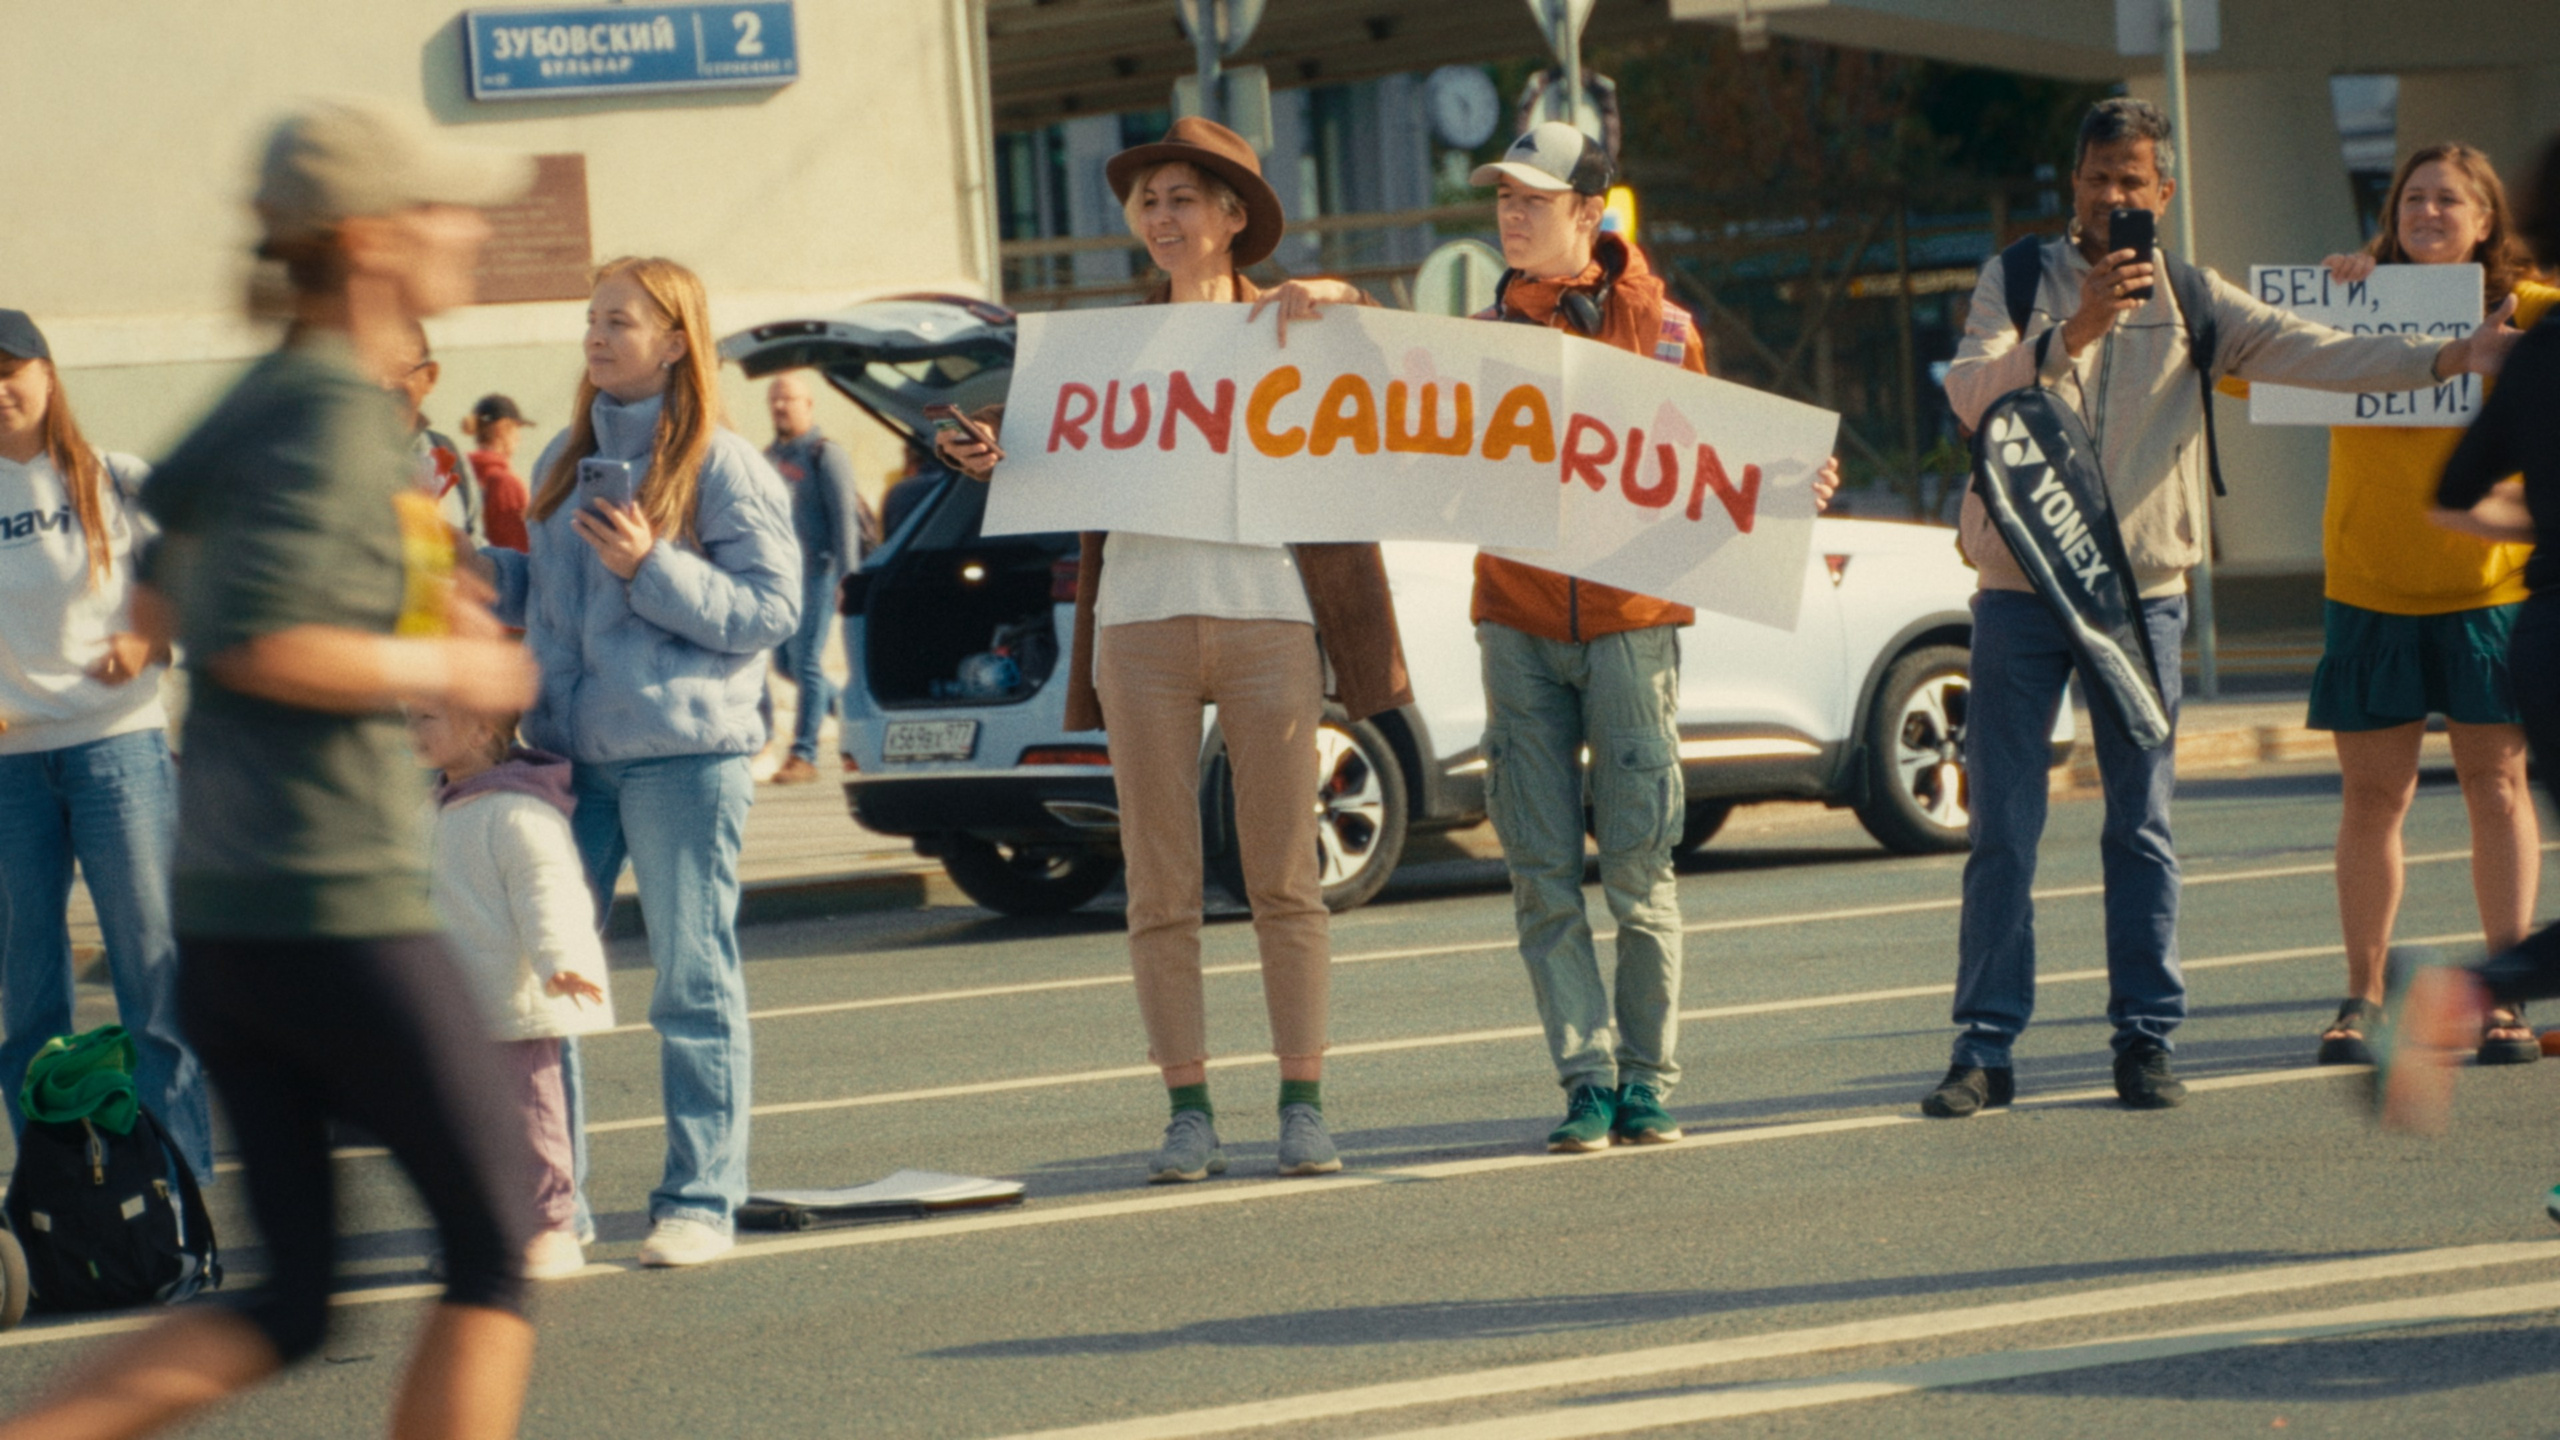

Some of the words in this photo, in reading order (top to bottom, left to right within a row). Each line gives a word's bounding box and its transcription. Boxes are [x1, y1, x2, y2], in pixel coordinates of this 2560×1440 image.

[493, 15, 676, 60] ЗУБОВСКИЙ
[732, 11, 764, 56] 2
[540, 56, 633, 77] БУЛЬВАР
[2260, 268, 2379, 313] БЕГИ,
[1046, 370, 1236, 454] RUN
[1246, 365, 1557, 463] САША
[1559, 411, 1762, 534] RUN
[2030, 466, 2110, 592] YONEX
